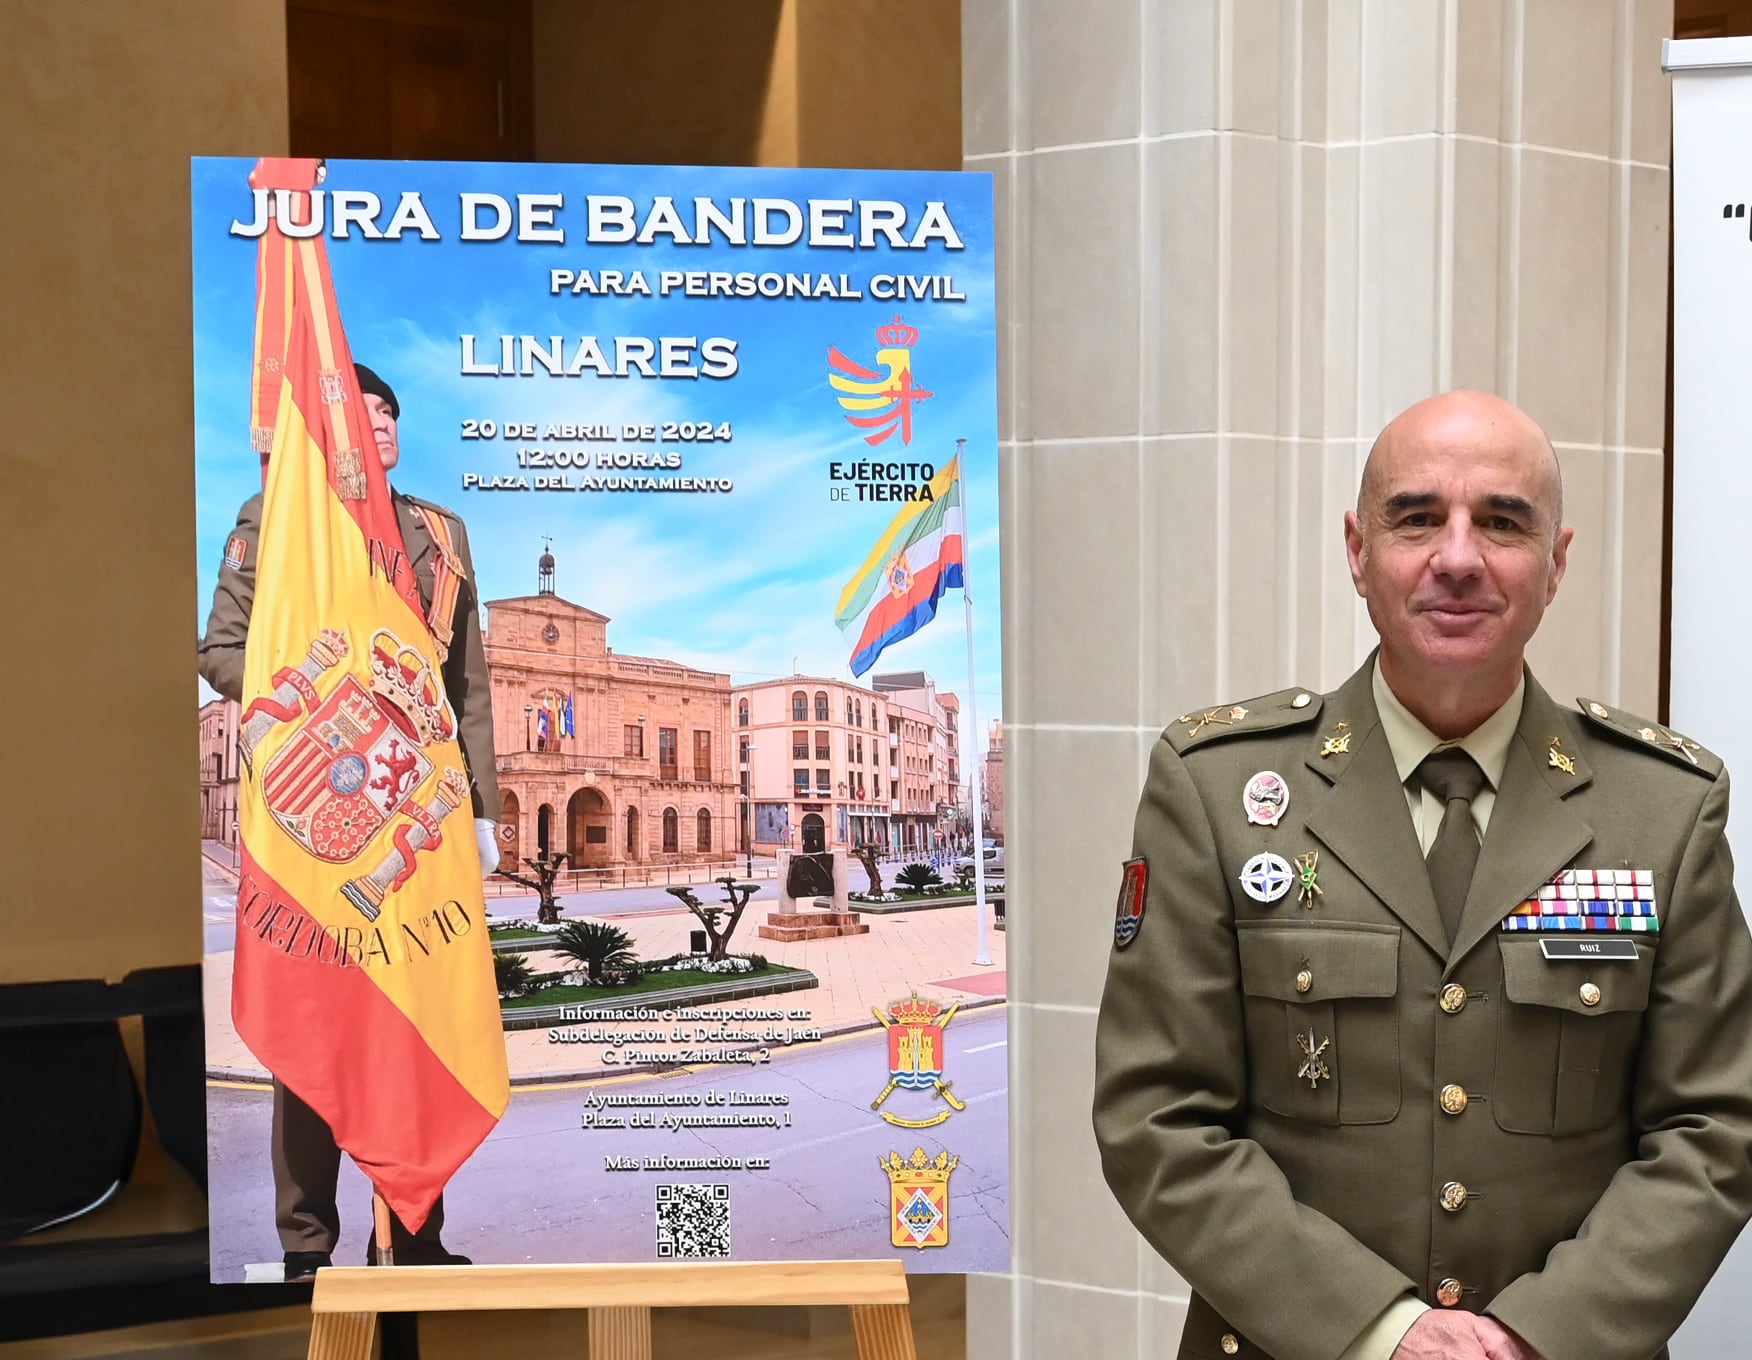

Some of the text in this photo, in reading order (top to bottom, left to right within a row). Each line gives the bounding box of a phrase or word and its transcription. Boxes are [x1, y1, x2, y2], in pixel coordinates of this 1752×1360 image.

[230, 189, 966, 249] JURA DE BANDERA
[550, 268, 966, 300] PARA PERSONAL CIVIL
[460, 334, 739, 378] LINARES
[461, 418, 733, 442] 20 DE ABRIL DE 2024
[517, 448, 682, 469] 12:00 HORAS
[830, 458, 935, 481] EJÉRCITO
[463, 472, 529, 489] PLAZA
[579, 475, 733, 492] AYUNTAMIENTO
[830, 483, 934, 502] DE TIERRA
[287, 671, 315, 700] PLVS
[1579, 943, 1601, 953] RUIZ
[559, 1005, 812, 1024] Información e inscripciones en:
[670, 1027, 691, 1042] de
[695, 1027, 759, 1043] Defensa
[761, 1028, 783, 1043] de
[602, 1048, 771, 1065] C. Pintor Zabaleta, 2
[585, 1090, 789, 1109] Ayuntamiento de Linares
[582, 1112, 792, 1131] Plaza del Ayuntamiento, 1
[605, 1155, 770, 1171] Más información en:
